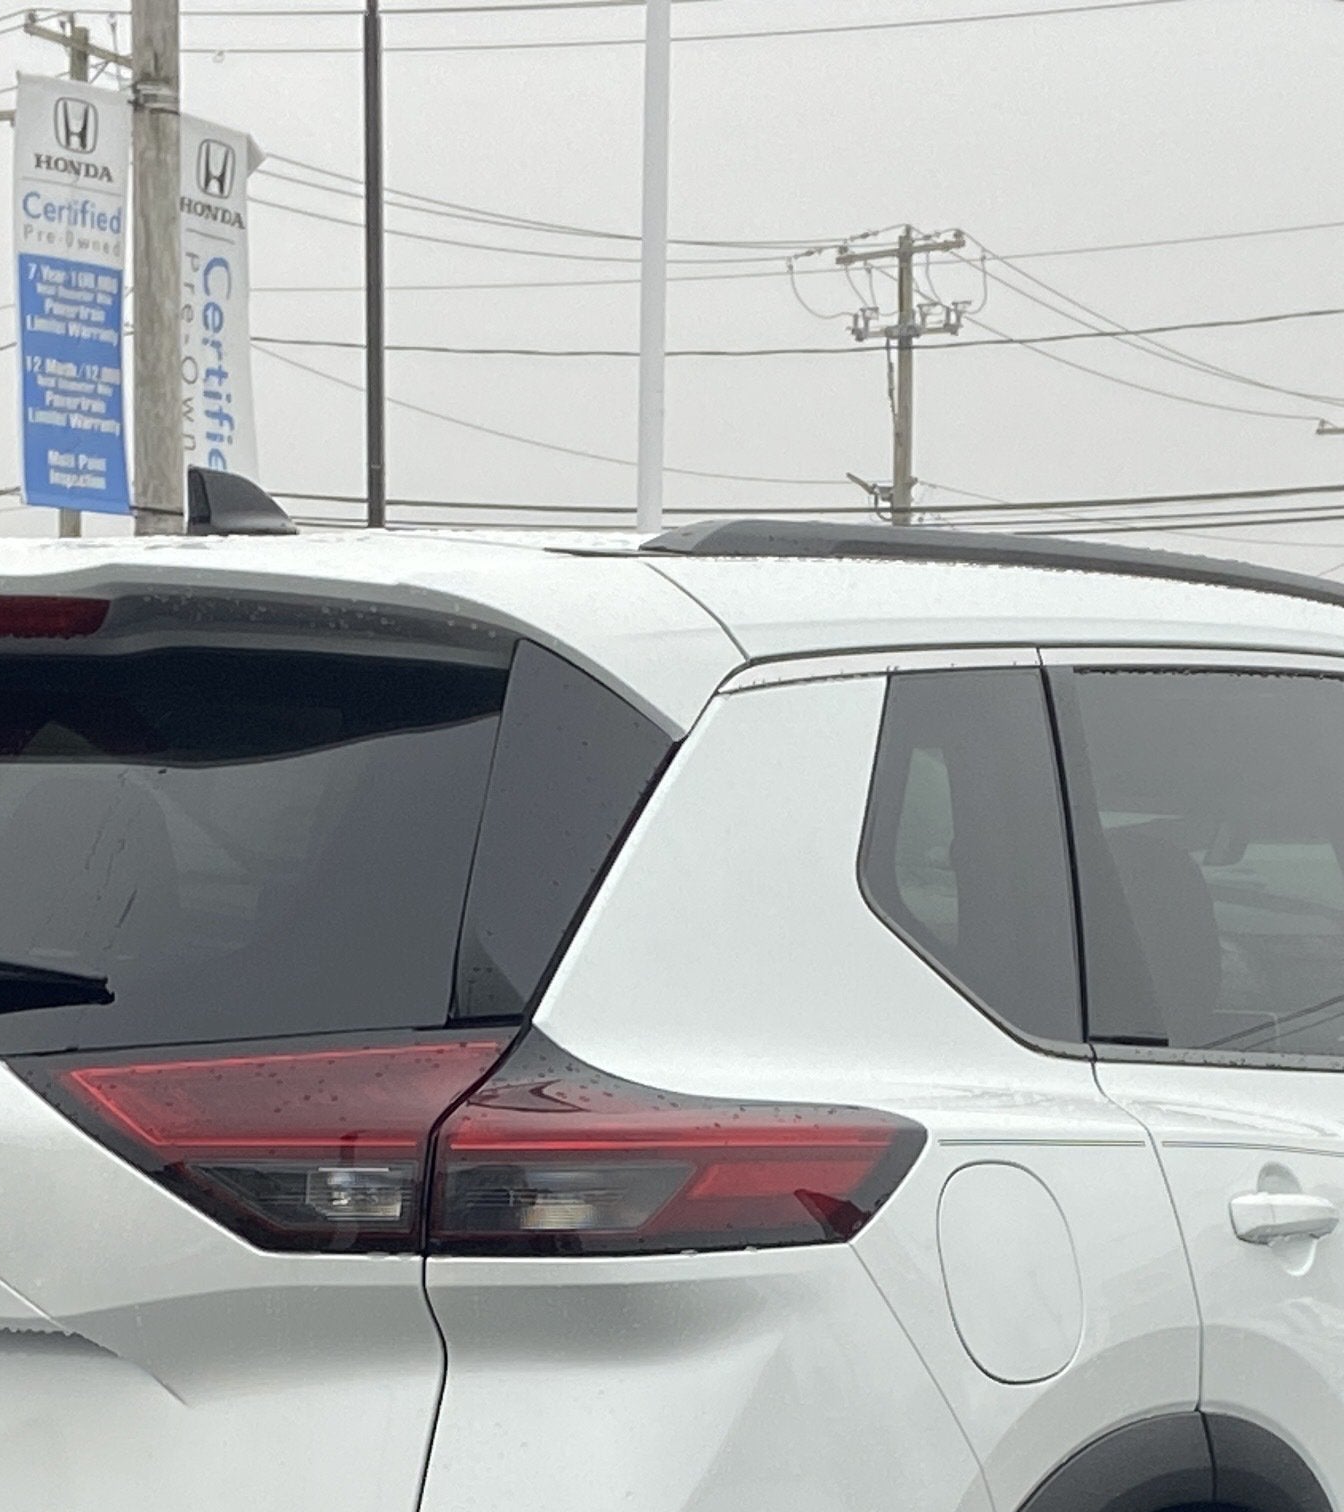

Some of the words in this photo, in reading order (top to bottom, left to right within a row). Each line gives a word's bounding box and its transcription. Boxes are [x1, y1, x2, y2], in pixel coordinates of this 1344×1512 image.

[33, 153, 114, 183] HONDA
[22, 190, 123, 235] Certified
[179, 196, 246, 230] HONDA
[180, 251, 201, 452] Pre-Own
[202, 256, 236, 471] Certifie
